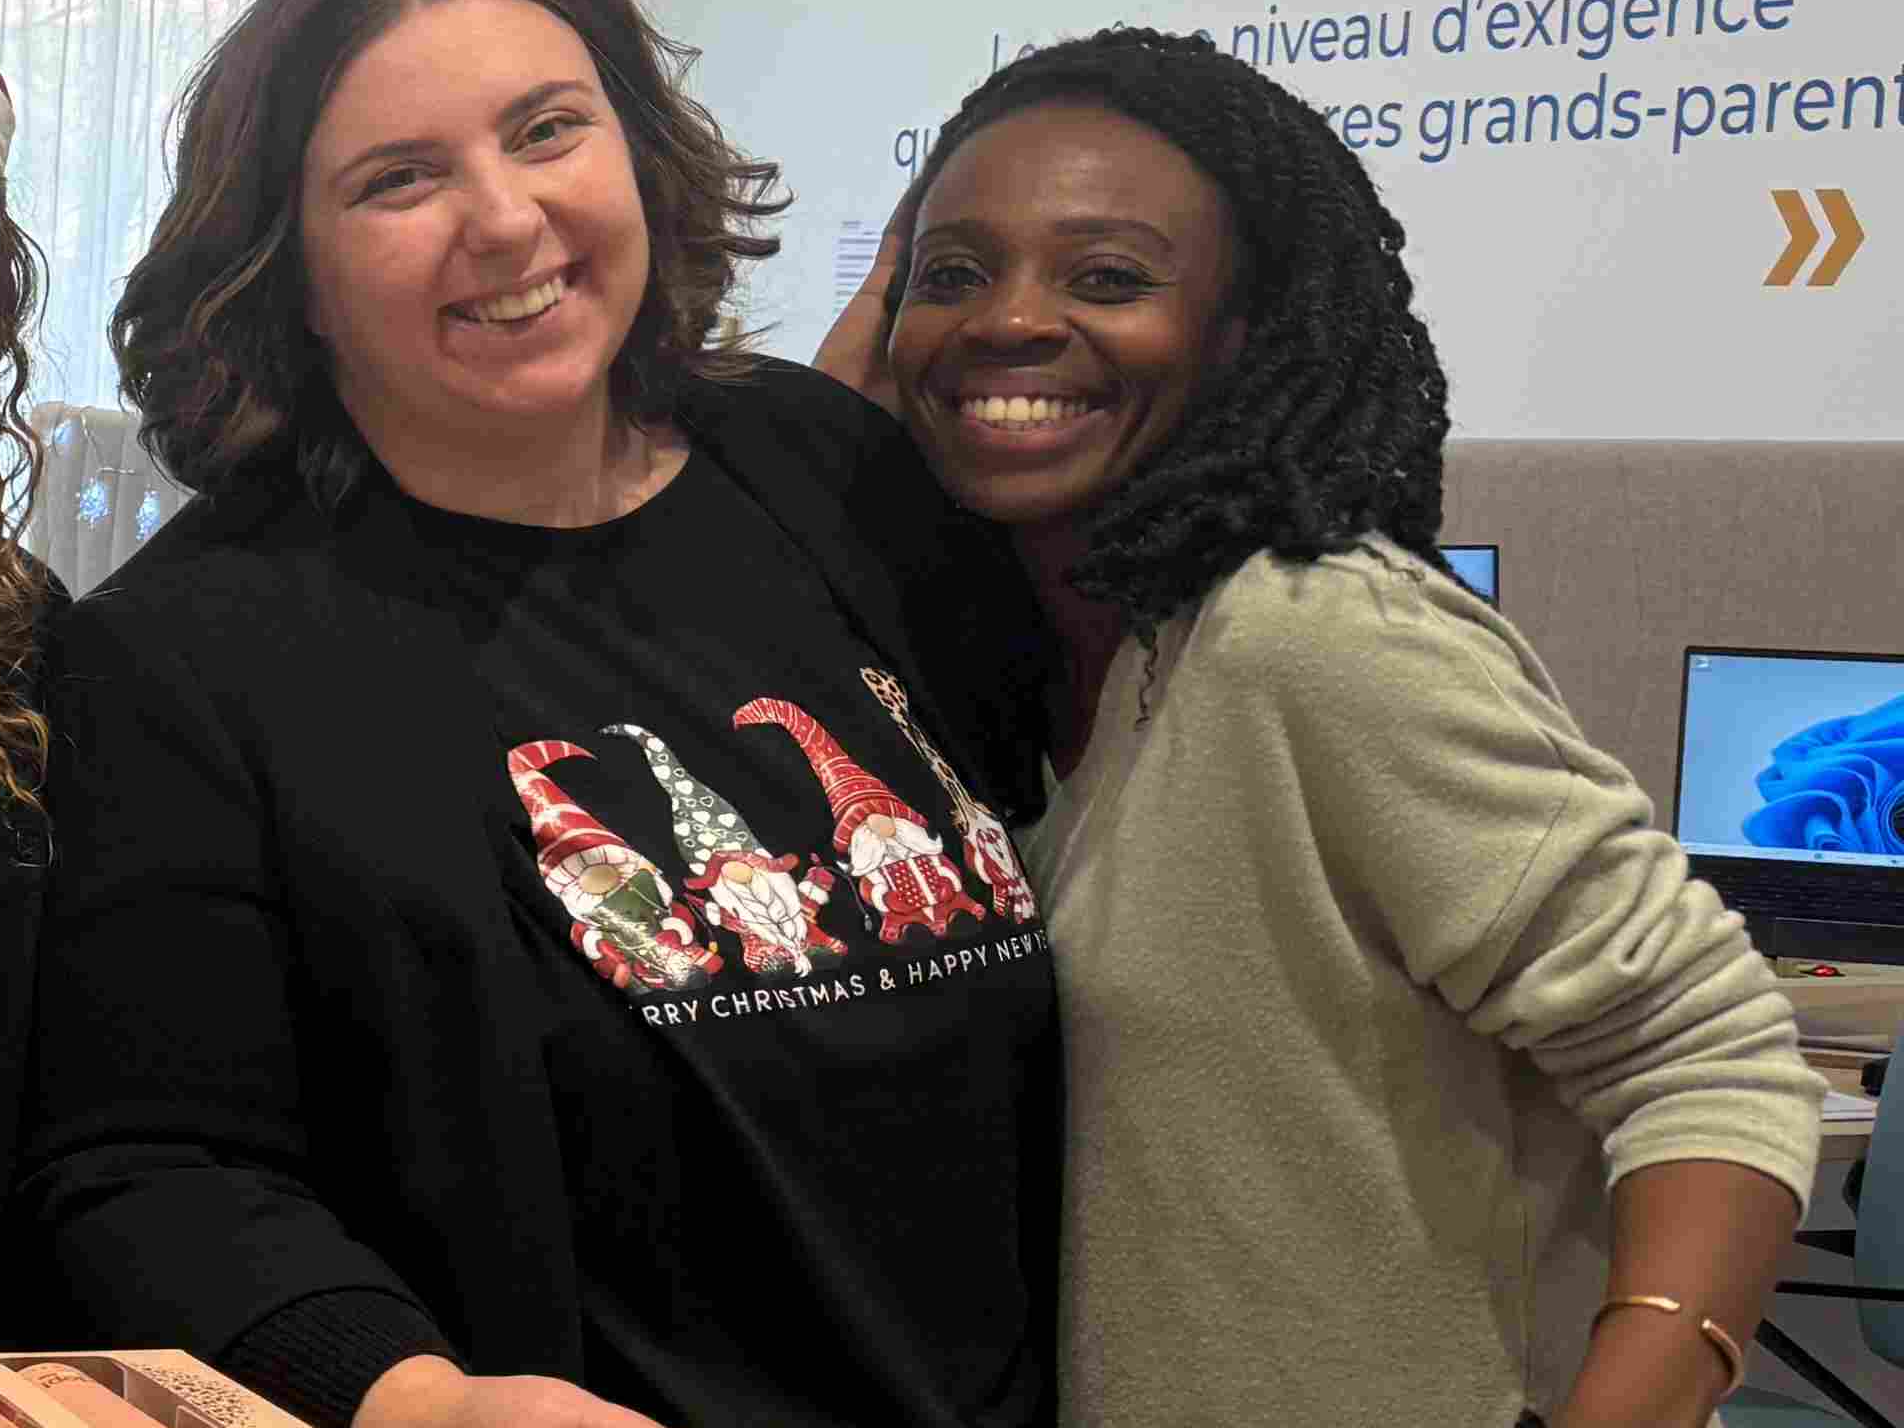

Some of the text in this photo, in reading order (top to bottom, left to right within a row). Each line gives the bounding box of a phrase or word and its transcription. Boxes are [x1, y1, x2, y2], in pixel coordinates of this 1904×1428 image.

[1232, 4, 1411, 67] niveau
[642, 999, 699, 1027] RRY
[711, 974, 867, 1019] CHRISTMAS
[879, 968, 897, 992] &
[907, 944, 988, 986] HAPPY
[995, 932, 1033, 963] NEW
